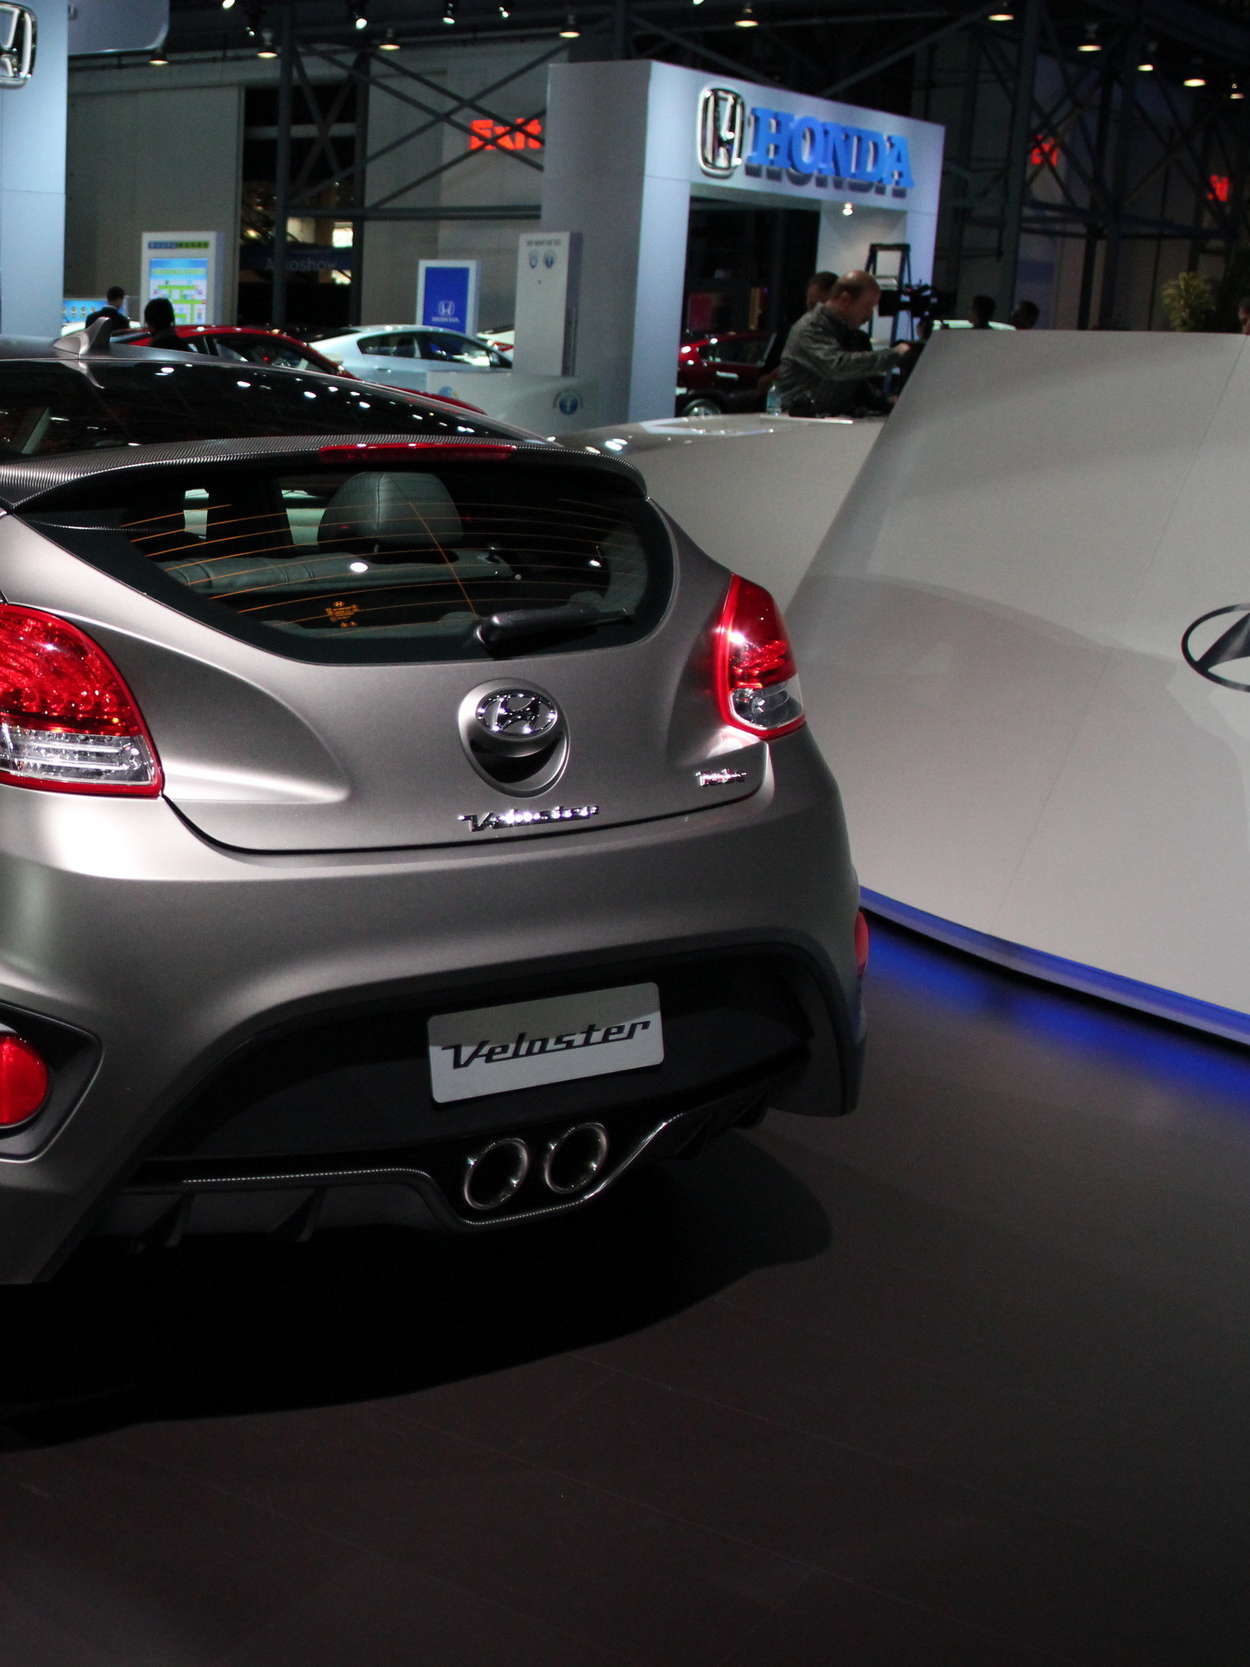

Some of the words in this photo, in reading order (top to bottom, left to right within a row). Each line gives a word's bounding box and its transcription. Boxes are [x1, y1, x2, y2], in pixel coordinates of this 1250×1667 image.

[470, 117, 543, 151] Exit
[746, 106, 914, 188] HONDA
[441, 1020, 651, 1069] Veloster
